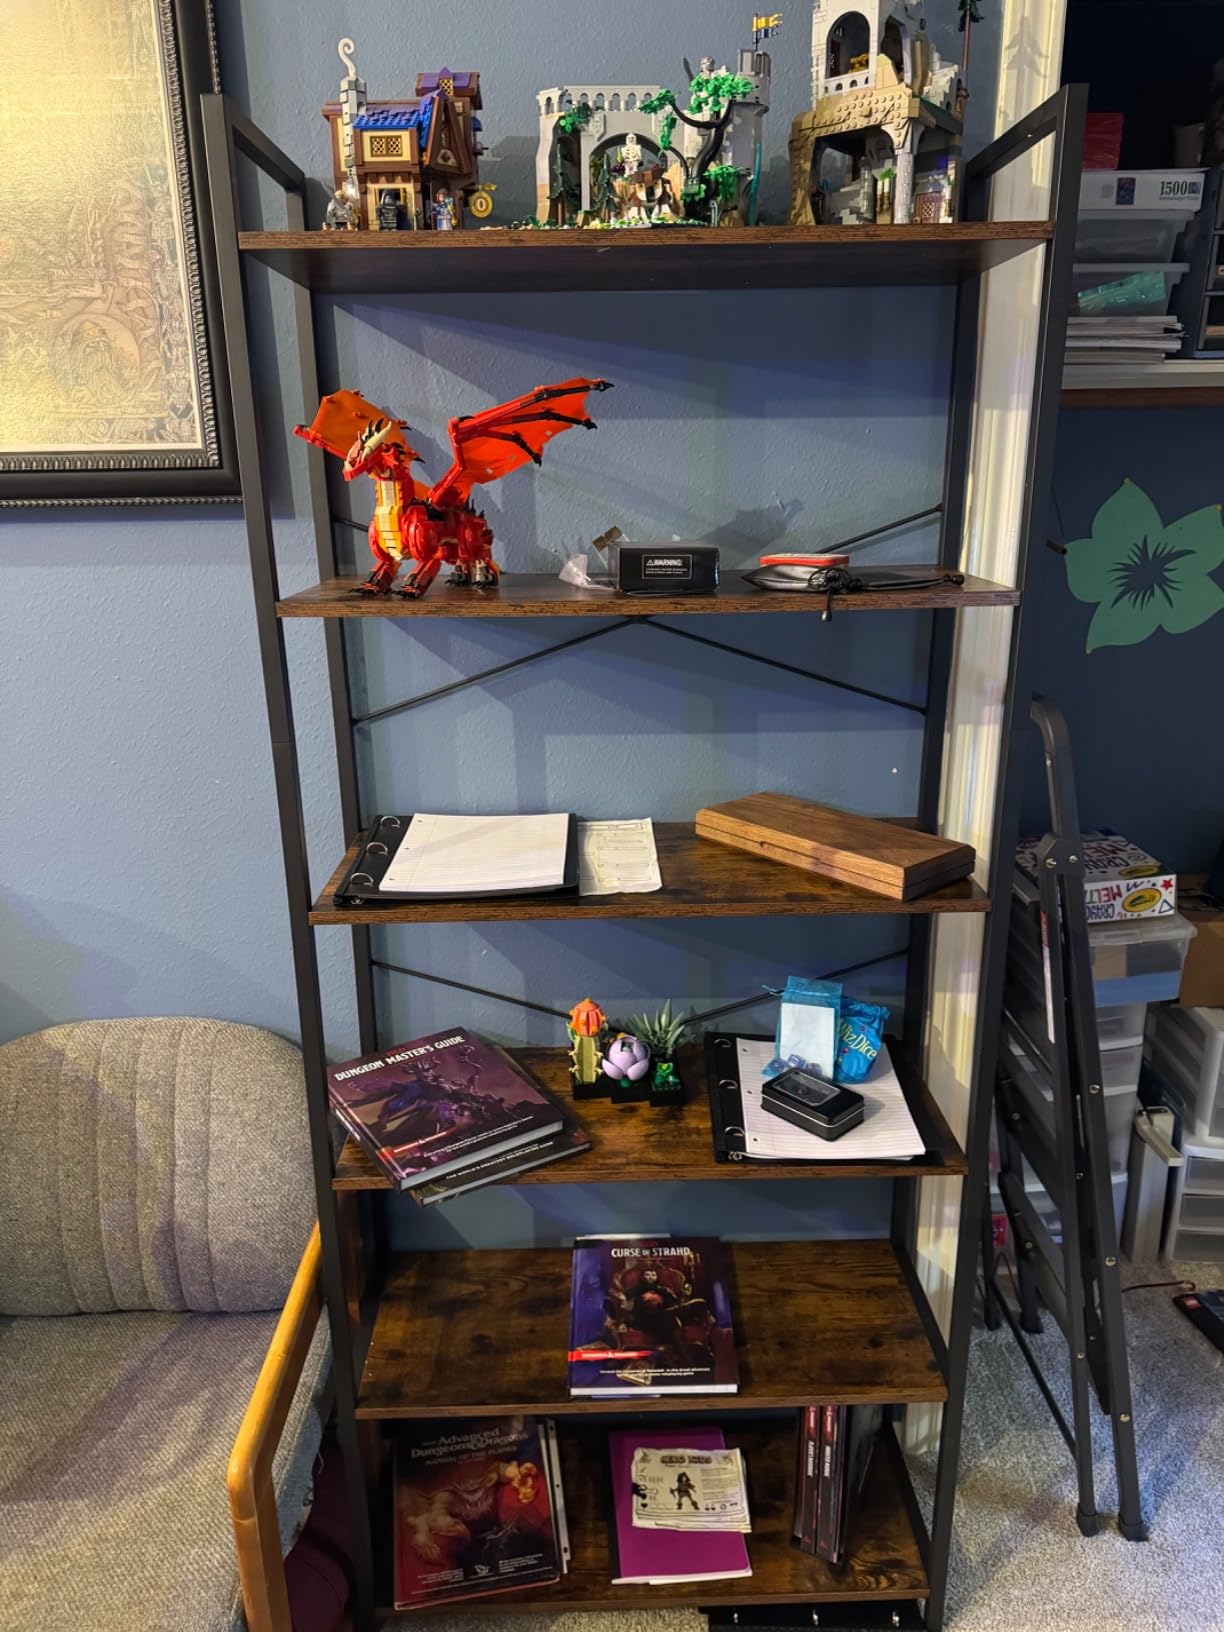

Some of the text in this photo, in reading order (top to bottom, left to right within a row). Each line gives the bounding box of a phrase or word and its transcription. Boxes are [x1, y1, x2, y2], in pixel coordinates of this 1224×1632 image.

[1160, 181, 1188, 195] 1500
[1084, 885, 1123, 904] MELT
[1085, 903, 1115, 920] CRAYO
[334, 1034, 466, 1081] DUNGEON MASTER'S GUIDE
[611, 1247, 640, 1258] CURSE
[652, 1246, 691, 1257] STRAHD
[438, 1428, 500, 1446] Advanced
